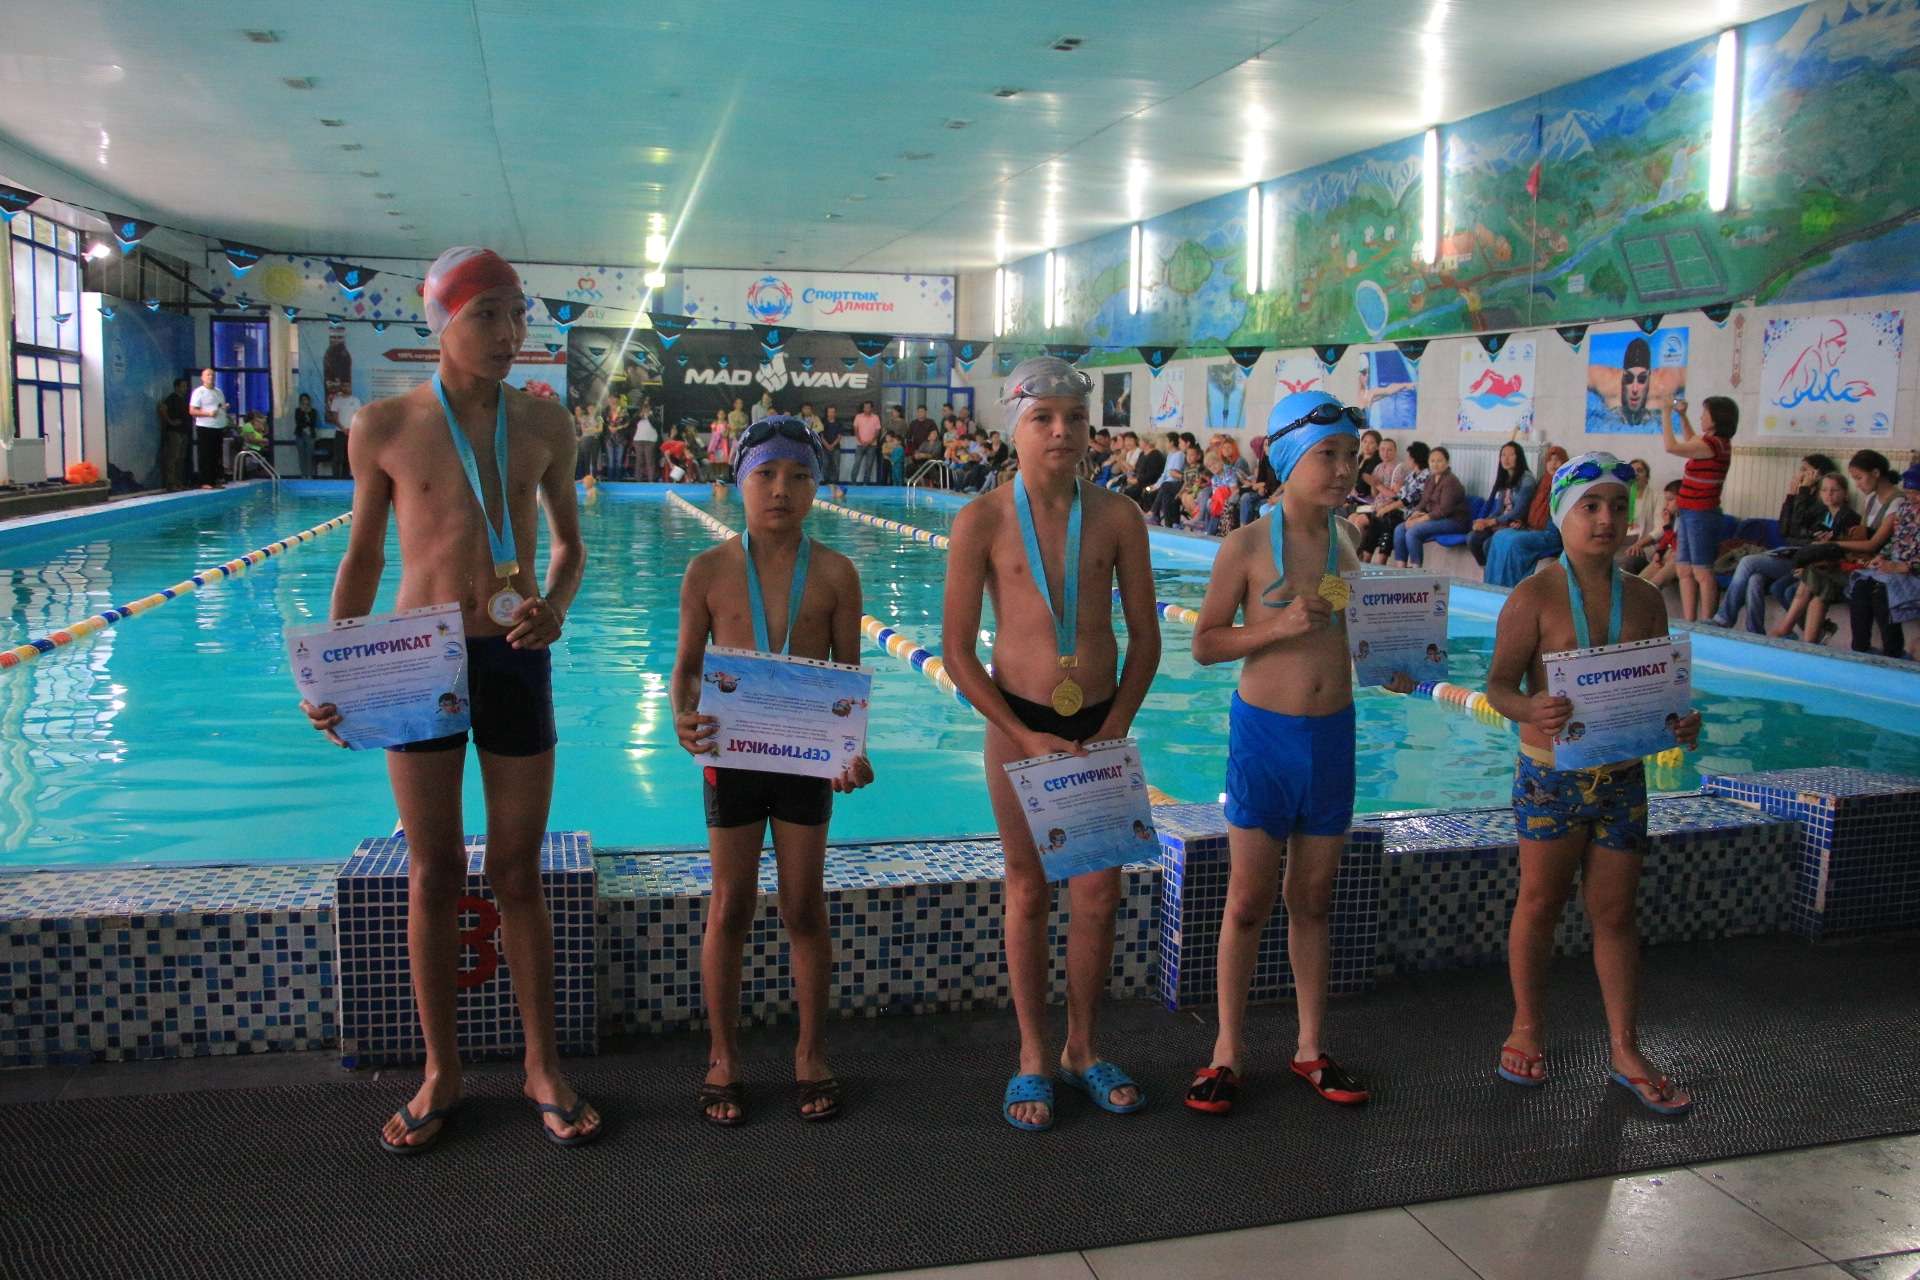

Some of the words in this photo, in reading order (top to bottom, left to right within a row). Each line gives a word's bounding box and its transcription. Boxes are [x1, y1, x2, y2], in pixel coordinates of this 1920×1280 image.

[684, 368, 753, 386] MAD
[790, 371, 869, 389] WAVE
[1362, 591, 1429, 606] СЕРТИФИКАТ
[323, 634, 432, 663] СЕРТИФИКАТ
[1577, 662, 1667, 686] СЕРТИФИКАТ
[727, 738, 831, 762] СЕРТИФИКАТ
[1044, 765, 1123, 792] СЕРТИФИКАТ
